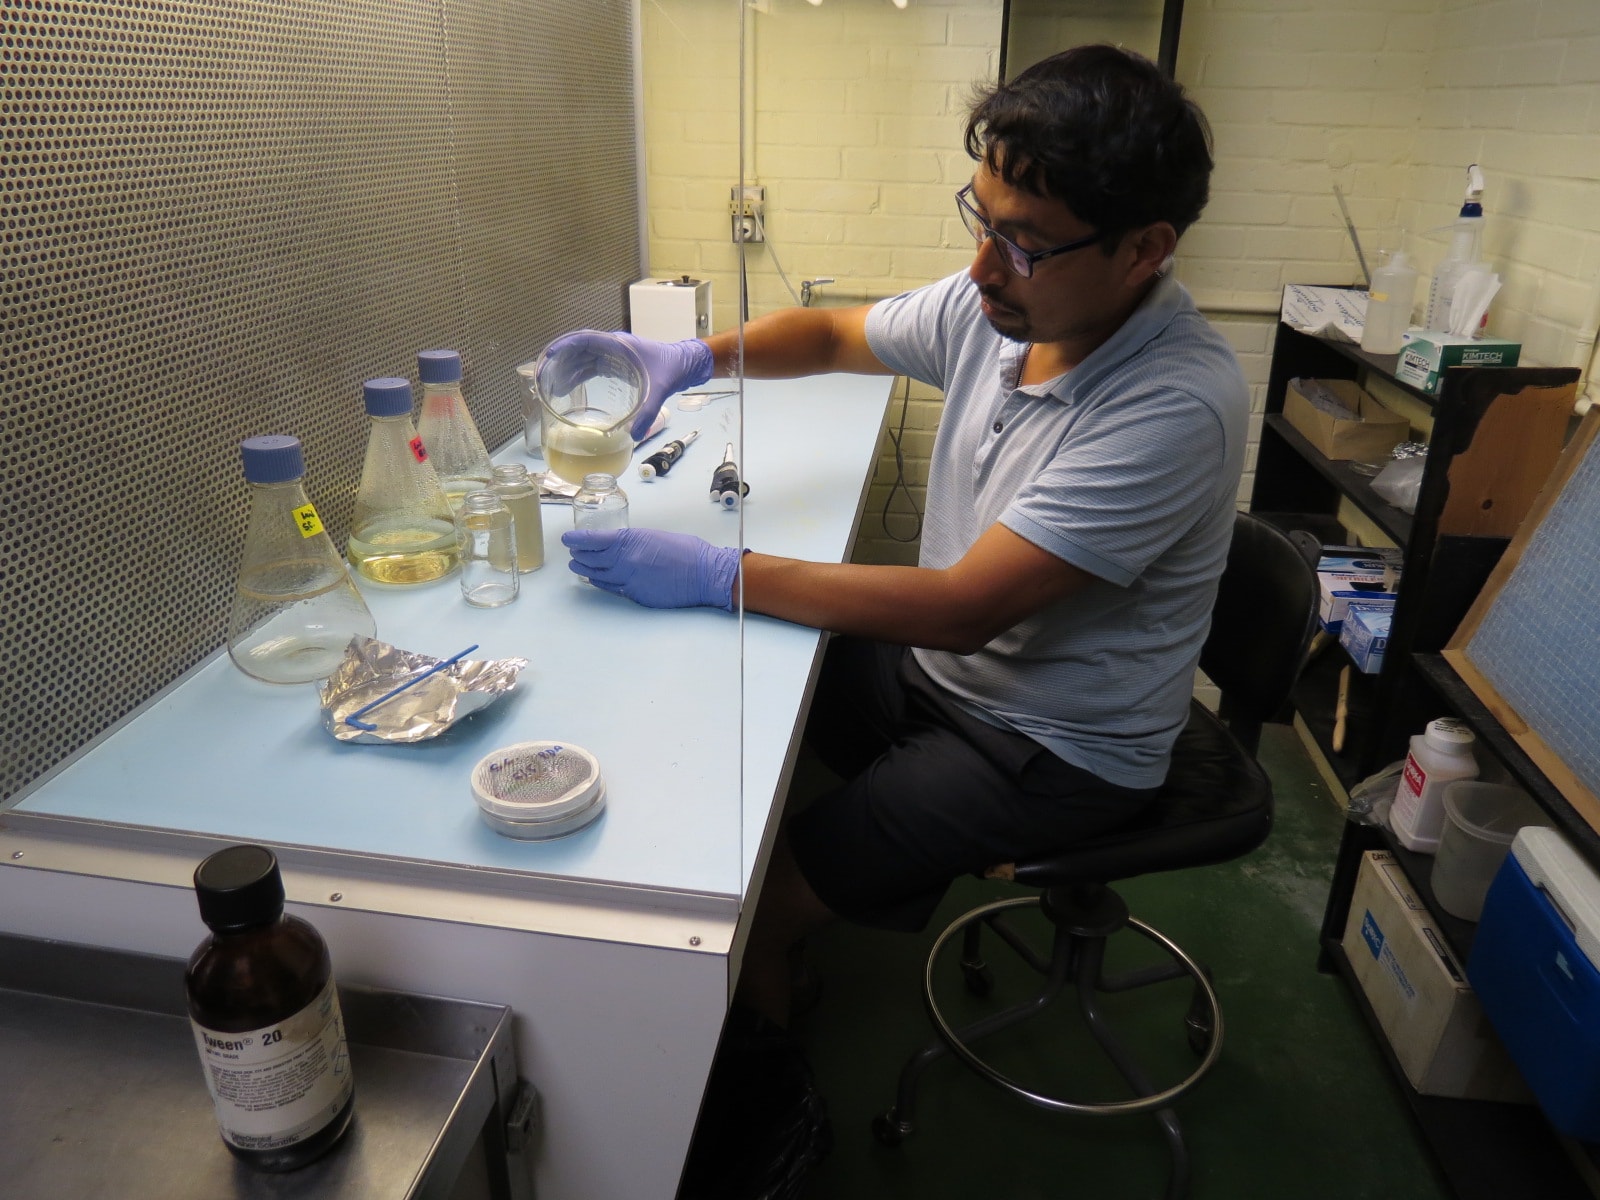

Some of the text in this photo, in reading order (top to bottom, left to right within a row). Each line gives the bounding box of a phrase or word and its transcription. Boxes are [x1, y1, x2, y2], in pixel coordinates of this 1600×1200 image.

[1405, 352, 1430, 369] KIMTECH
[1462, 352, 1503, 360] KIMTECH
[262, 1029, 283, 1046] 20
